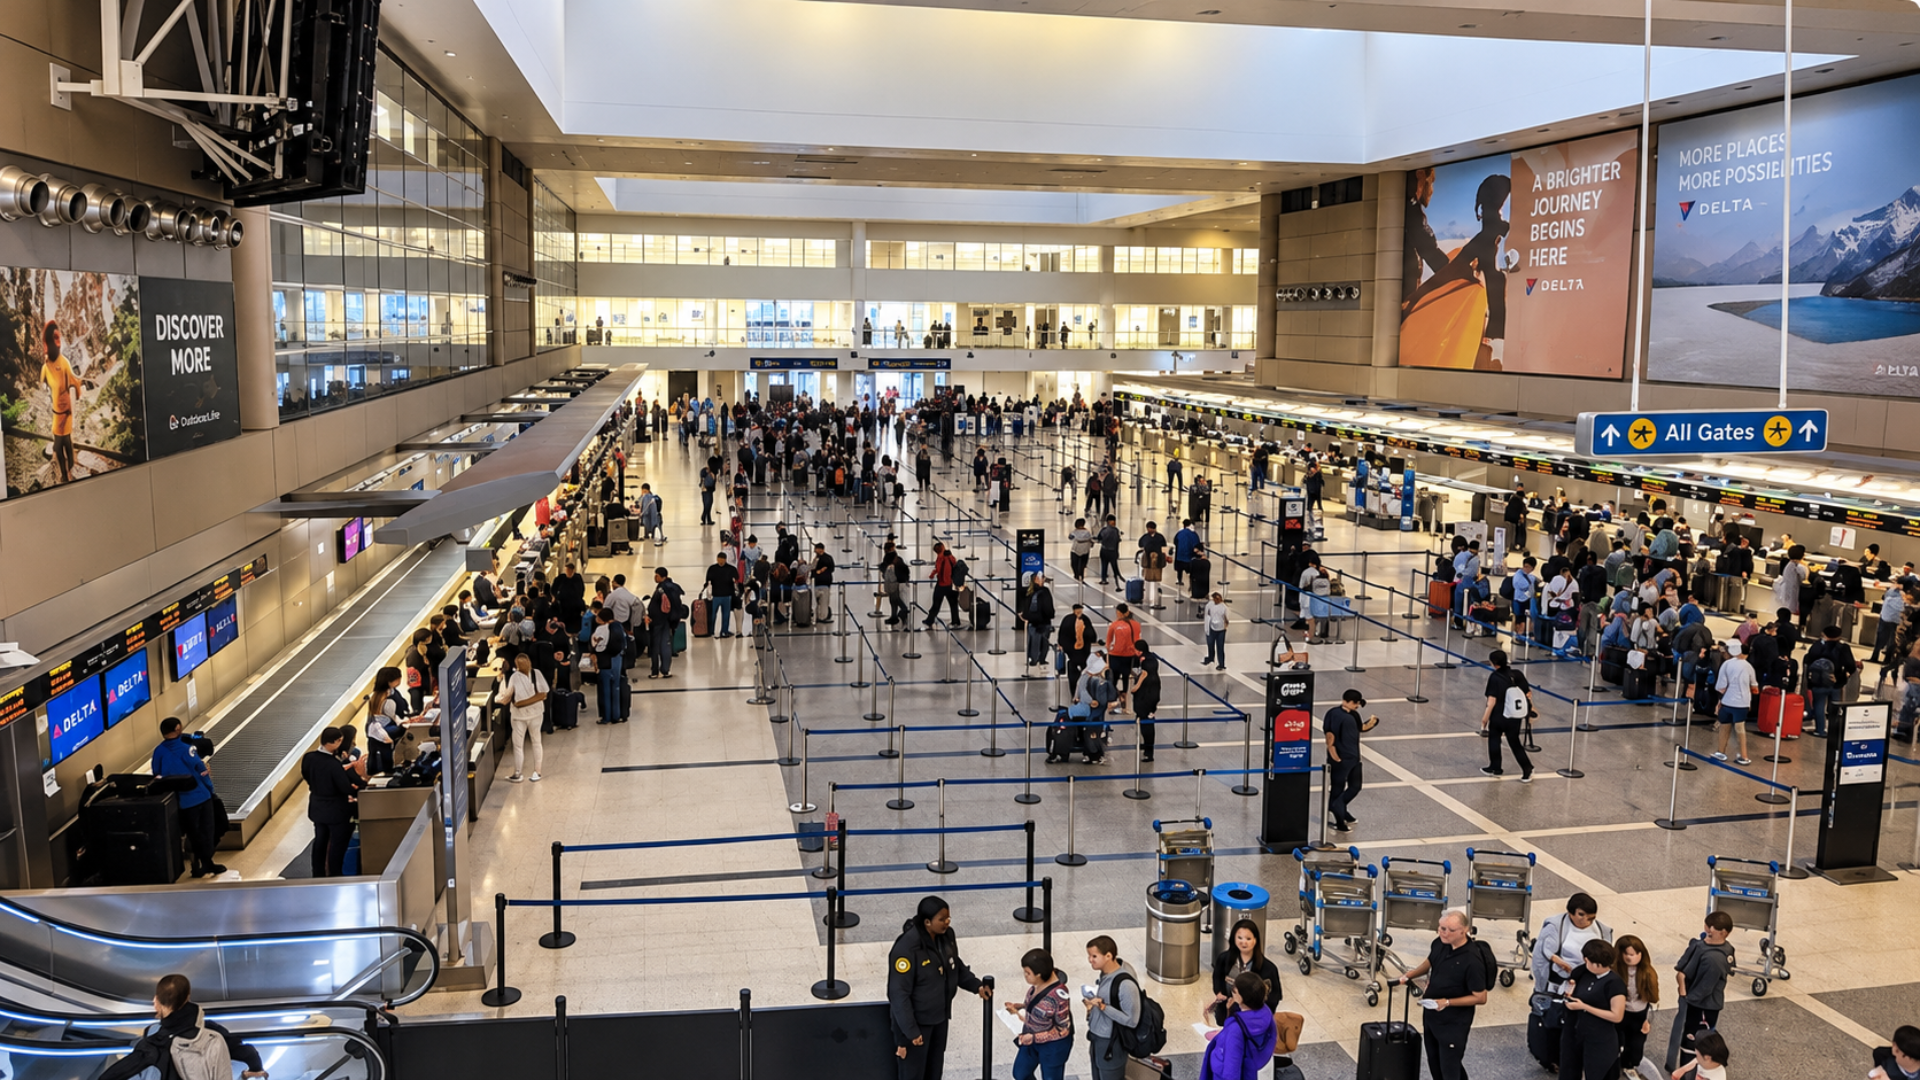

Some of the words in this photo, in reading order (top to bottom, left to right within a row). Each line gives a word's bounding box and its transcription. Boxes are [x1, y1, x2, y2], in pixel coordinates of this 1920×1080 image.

[1679, 144, 1722, 168] MORE
[1532, 174, 1543, 193] A
[1546, 160, 1622, 191] BRIGHTER
[1678, 169, 1721, 192] MORE
[1530, 188, 1603, 217] JOURNEY
[1700, 198, 1753, 215] DELTA
[1530, 217, 1586, 242] BEGINS
[1528, 246, 1568, 267] HERE
[1541, 278, 1585, 291] DELTA
[155, 314, 225, 341] DISCOVER
[171, 345, 212, 376] MORE
[1664, 422, 1691, 441] All
[1697, 422, 1755, 441] Gates
[117, 671, 143, 697] DELTA
[63, 699, 97, 733] DELTA
